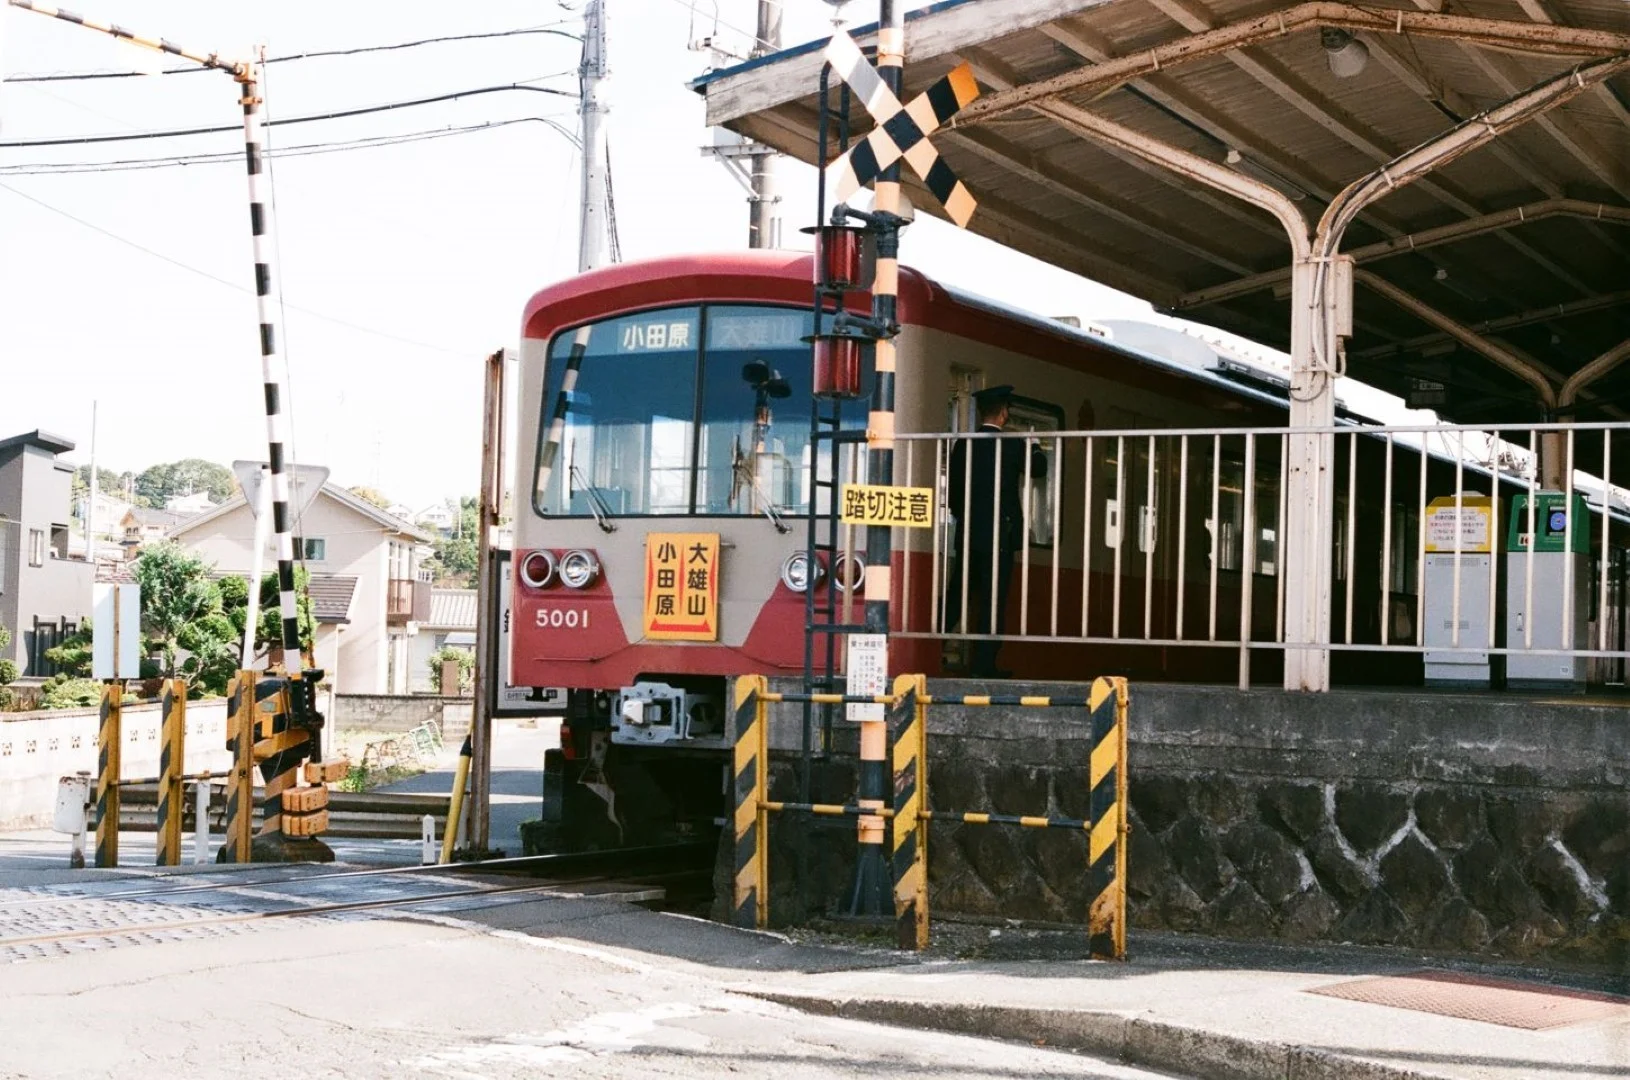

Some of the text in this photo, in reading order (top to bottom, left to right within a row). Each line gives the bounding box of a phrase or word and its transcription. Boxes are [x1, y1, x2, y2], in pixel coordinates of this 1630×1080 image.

[623, 322, 691, 349] 小田原
[719, 317, 796, 347] 大雄山
[845, 489, 930, 522] 踏切注意
[654, 541, 677, 616] 小田原
[687, 541, 708, 616] 大雄山
[535, 609, 589, 628] 5001
